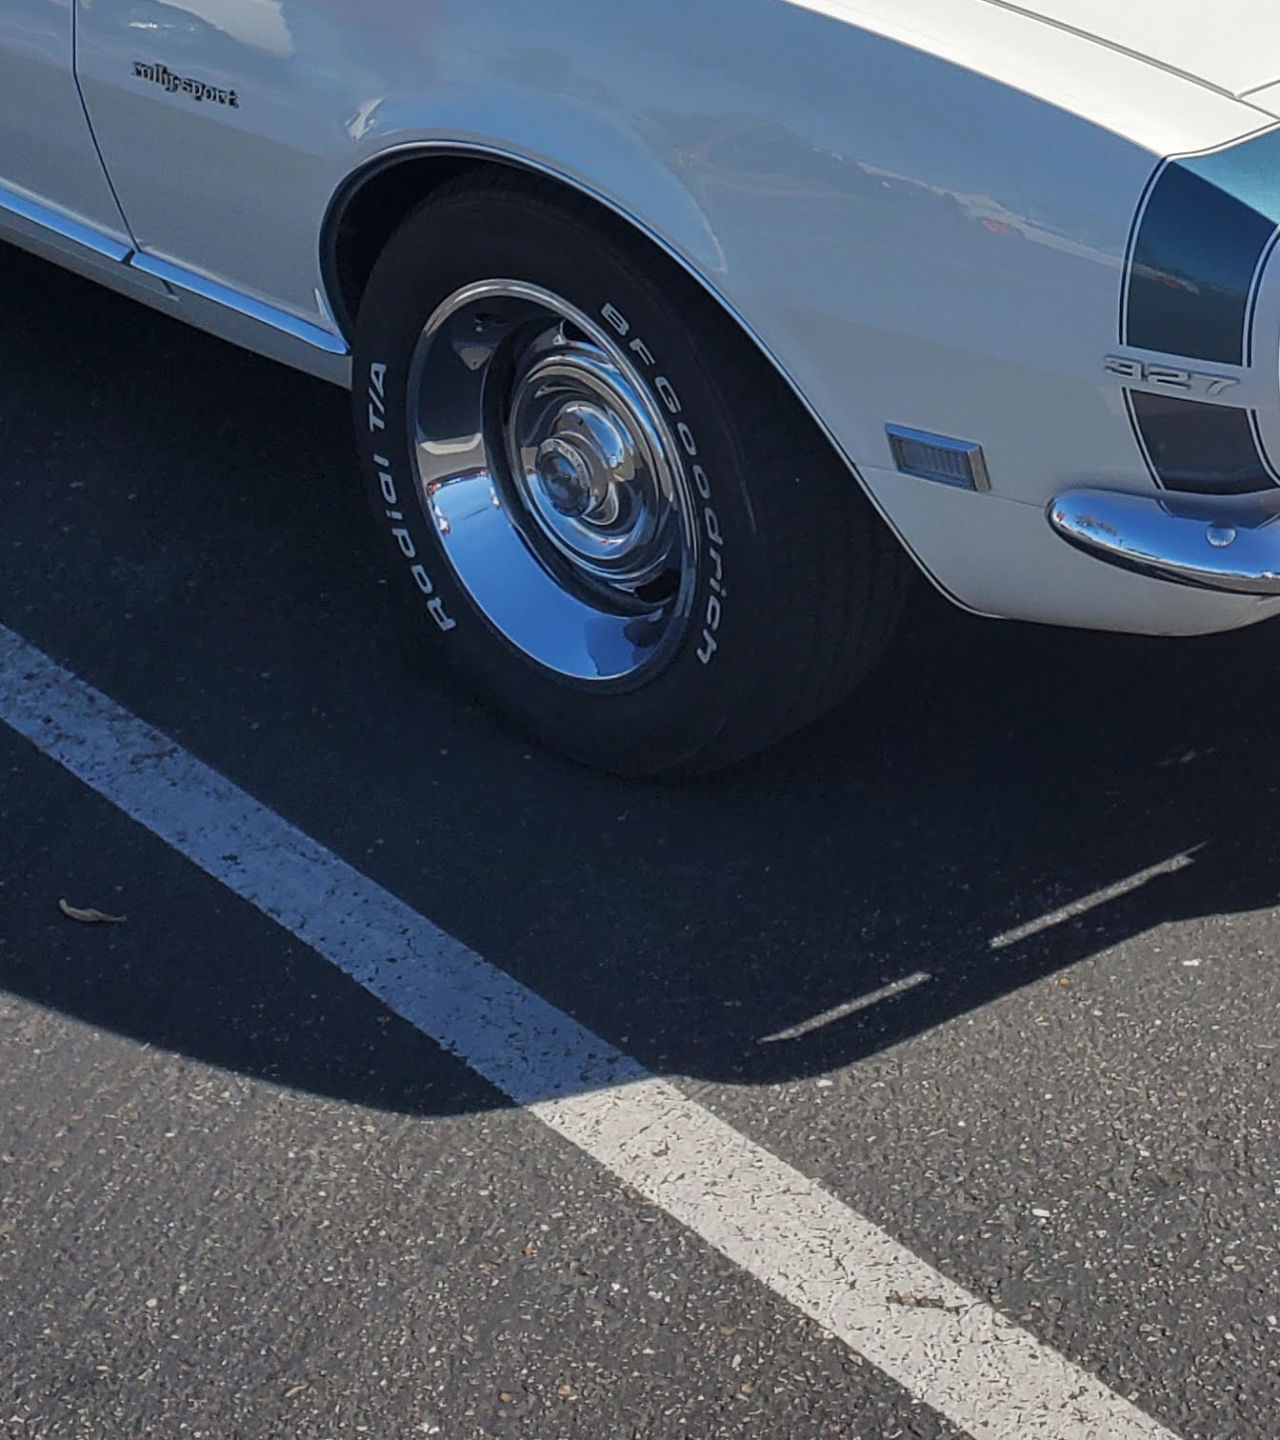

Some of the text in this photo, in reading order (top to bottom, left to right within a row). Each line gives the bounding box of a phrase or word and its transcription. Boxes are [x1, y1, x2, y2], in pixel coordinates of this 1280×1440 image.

[1103, 354, 1241, 396] 327
[367, 361, 458, 633] Radial T/A
